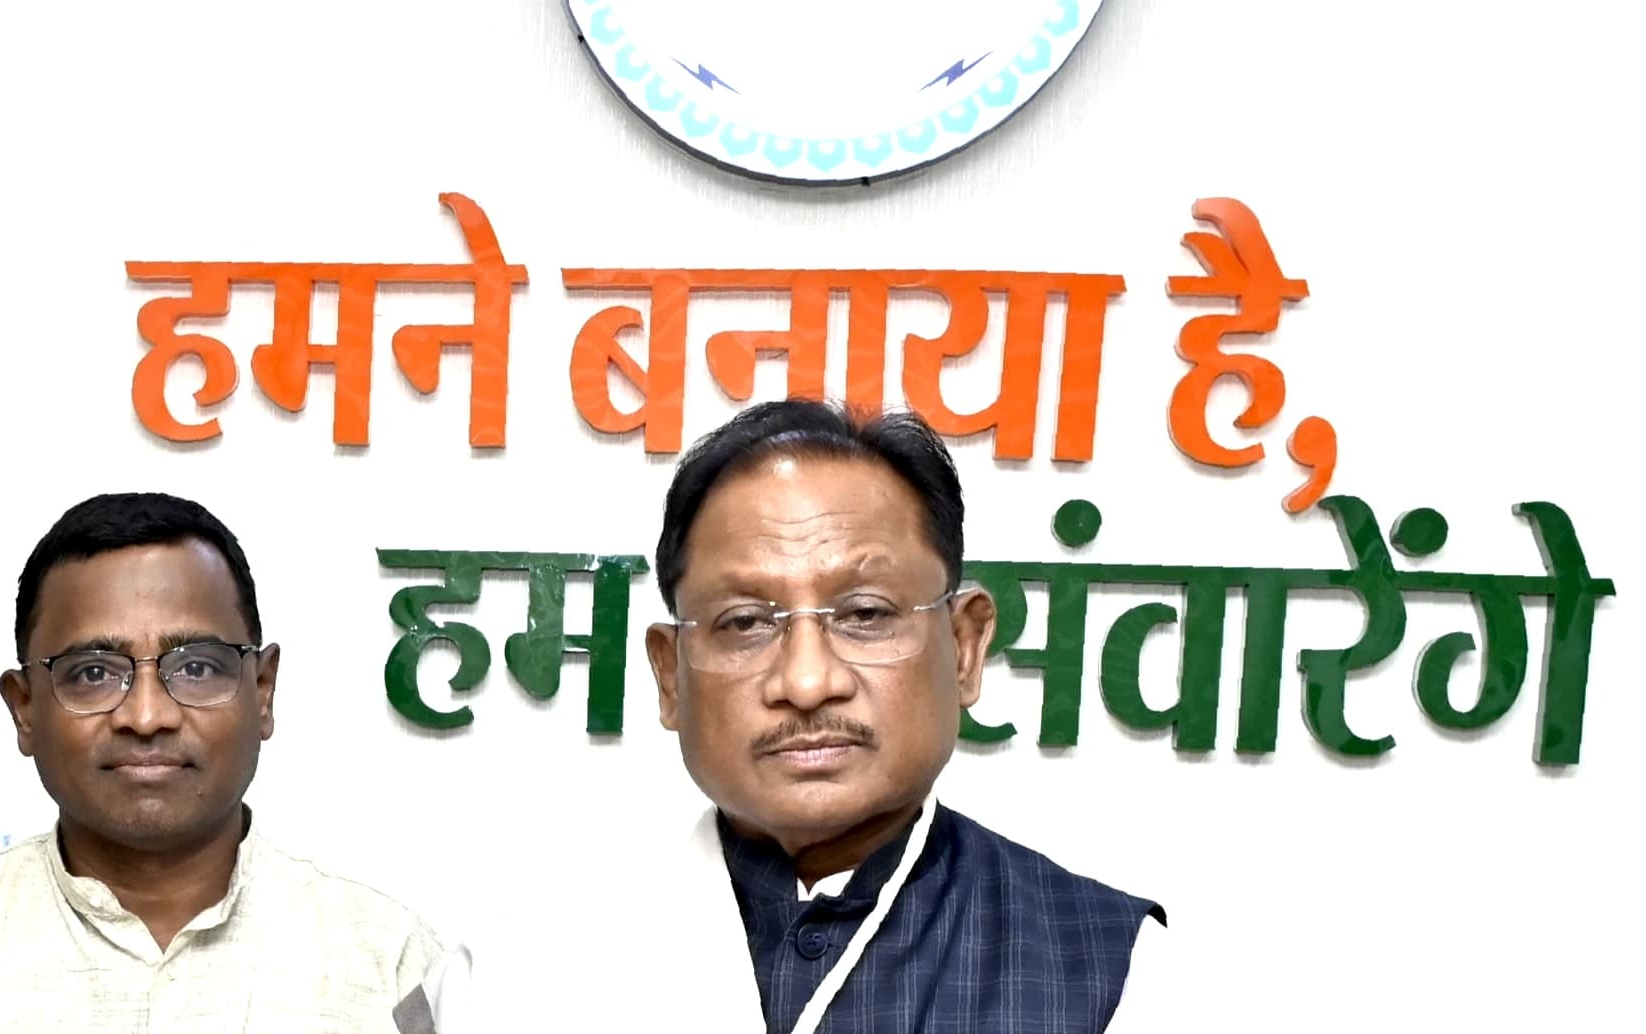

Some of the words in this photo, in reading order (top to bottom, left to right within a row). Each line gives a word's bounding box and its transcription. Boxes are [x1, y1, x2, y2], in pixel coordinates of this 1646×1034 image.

[125, 193, 530, 447] हमने
[561, 268, 1127, 460] बनाया
[1166, 198, 1338, 511] है,
[377, 549, 650, 733] हम
[960, 496, 1616, 765] संवारेंगे
